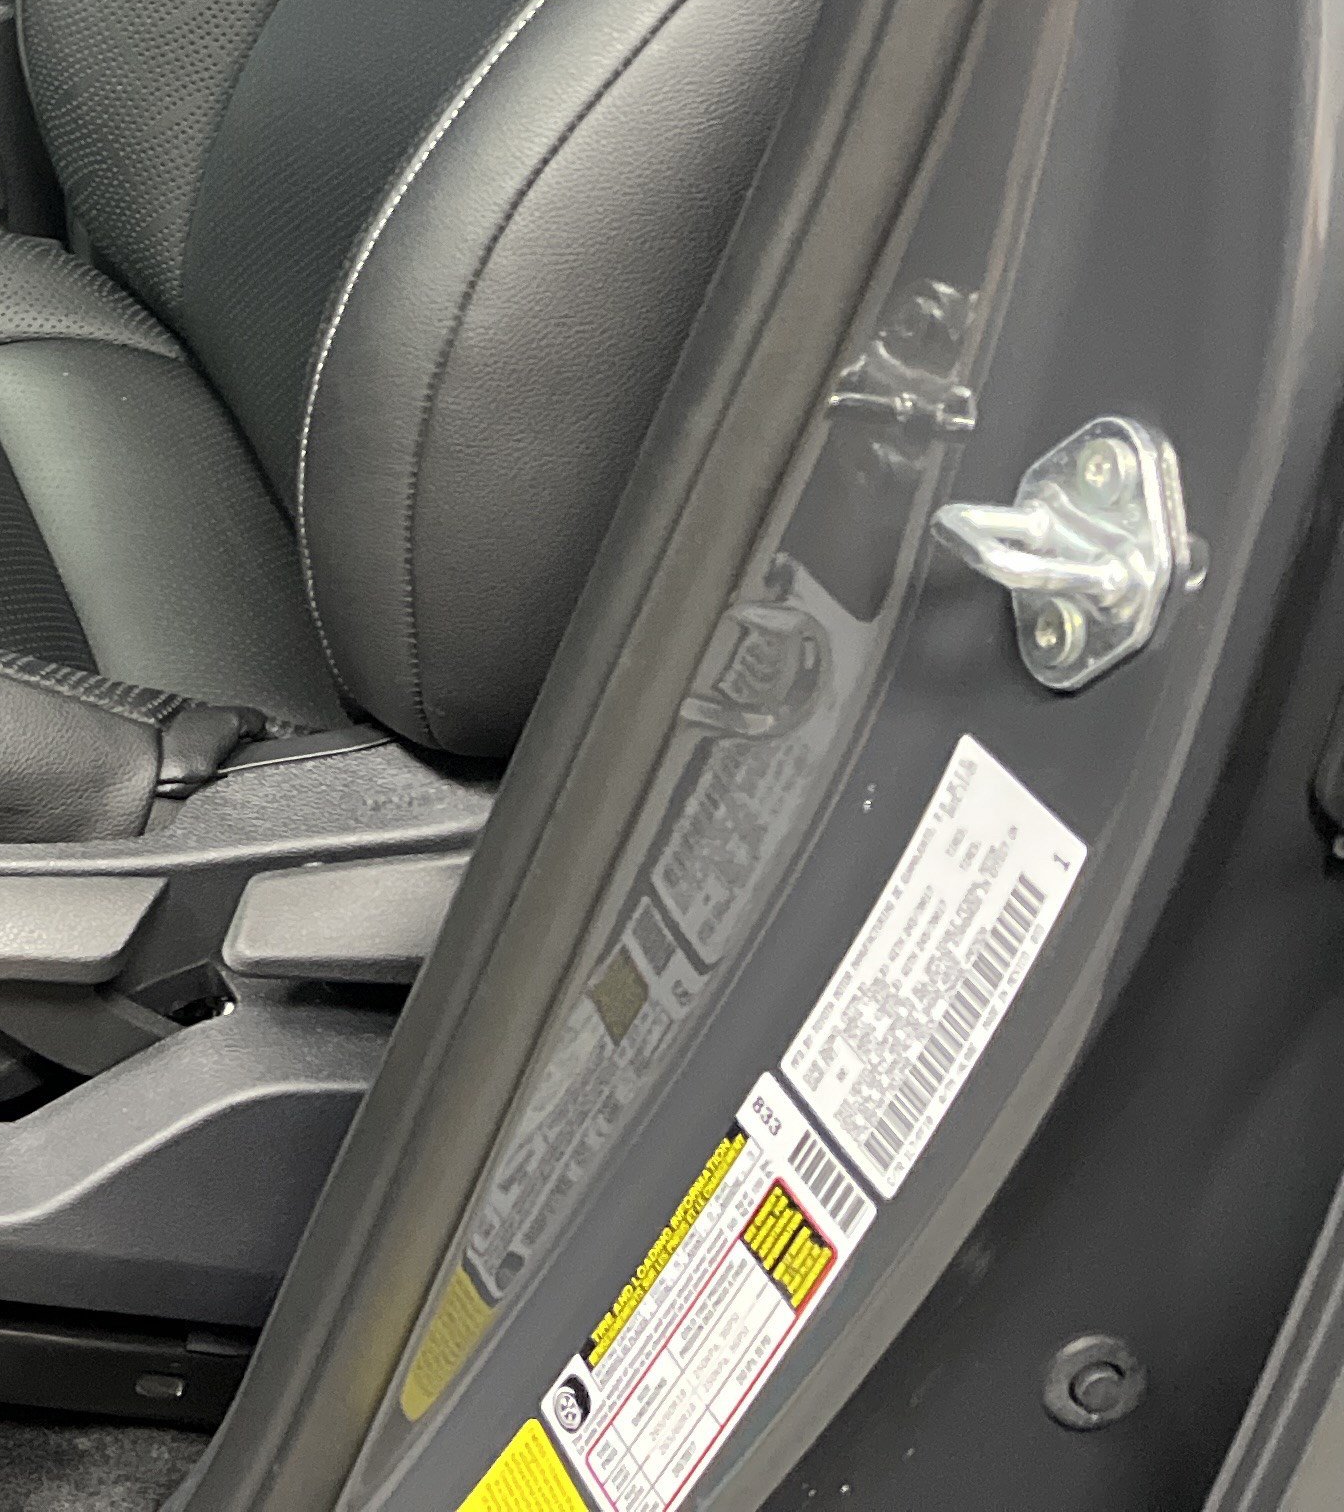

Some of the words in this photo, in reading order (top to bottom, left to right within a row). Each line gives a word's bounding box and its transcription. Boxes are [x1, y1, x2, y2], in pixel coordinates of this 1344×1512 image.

[752, 1095, 782, 1136] 833
[612, 1284, 634, 1317] AND
[631, 1226, 673, 1287] LOADING
[670, 1137, 732, 1229] INFORMATION
